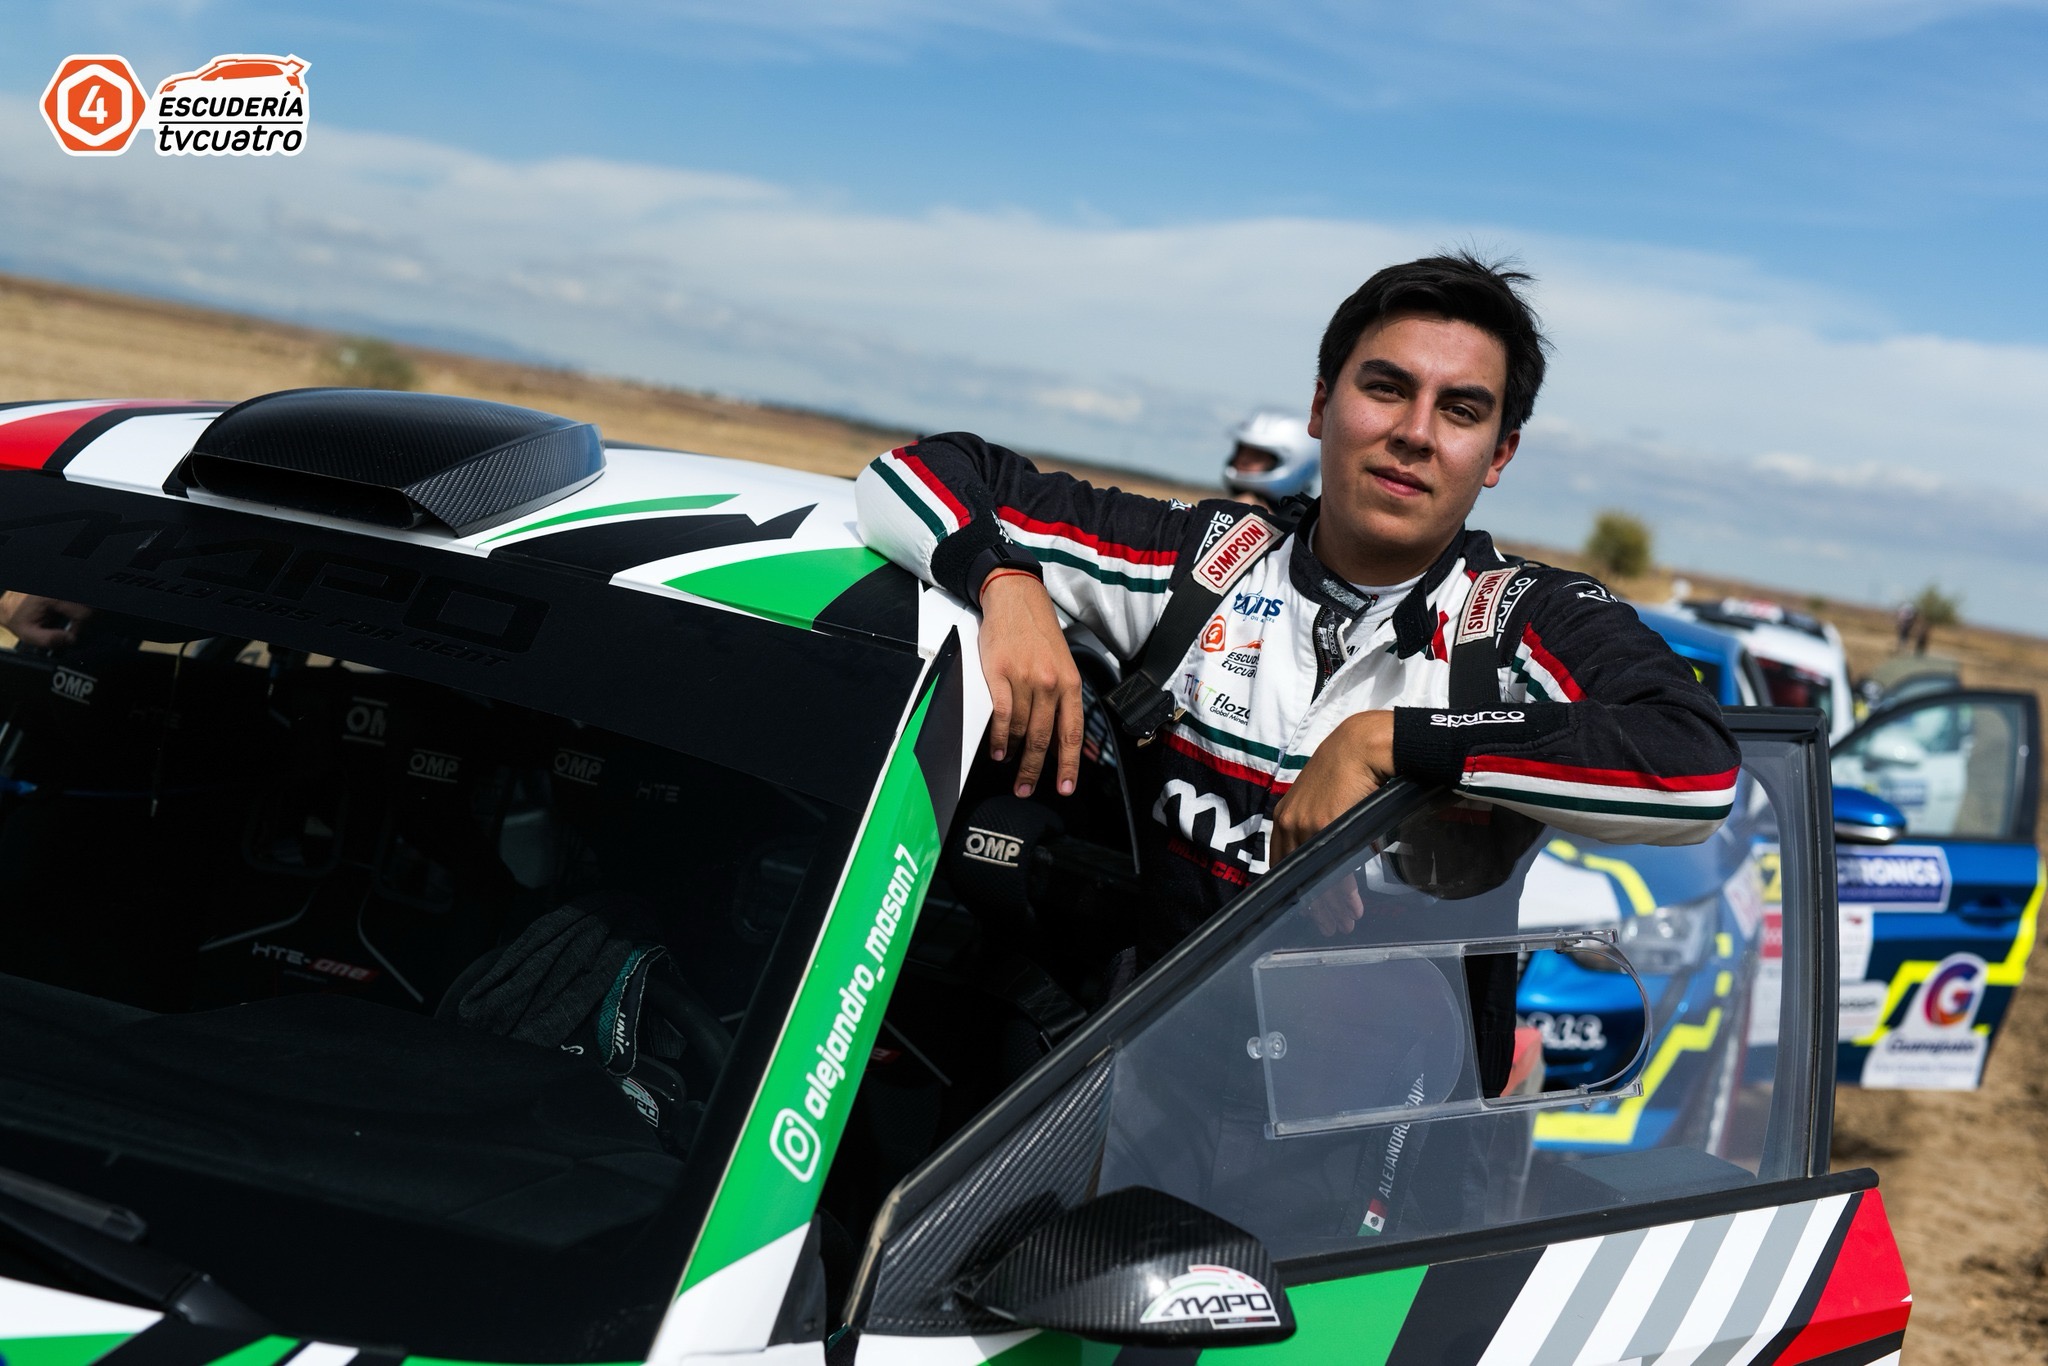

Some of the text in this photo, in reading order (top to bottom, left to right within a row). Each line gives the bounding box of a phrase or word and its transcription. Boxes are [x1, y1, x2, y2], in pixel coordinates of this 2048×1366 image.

[1207, 523, 1266, 582] SIMPSON
[1467, 573, 1504, 630] SIMPSON
[1496, 576, 1534, 635] parco
[1221, 660, 1257, 679] tvcua
[1227, 651, 1260, 666] ESCUD
[52, 672, 95, 700] OMP
[1429, 710, 1526, 728] sparco
[408, 751, 460, 779] OMP
[553, 751, 602, 780] OMP
[965, 832, 1021, 862] OMP
[1160, 1293, 1272, 1317] MAPO
